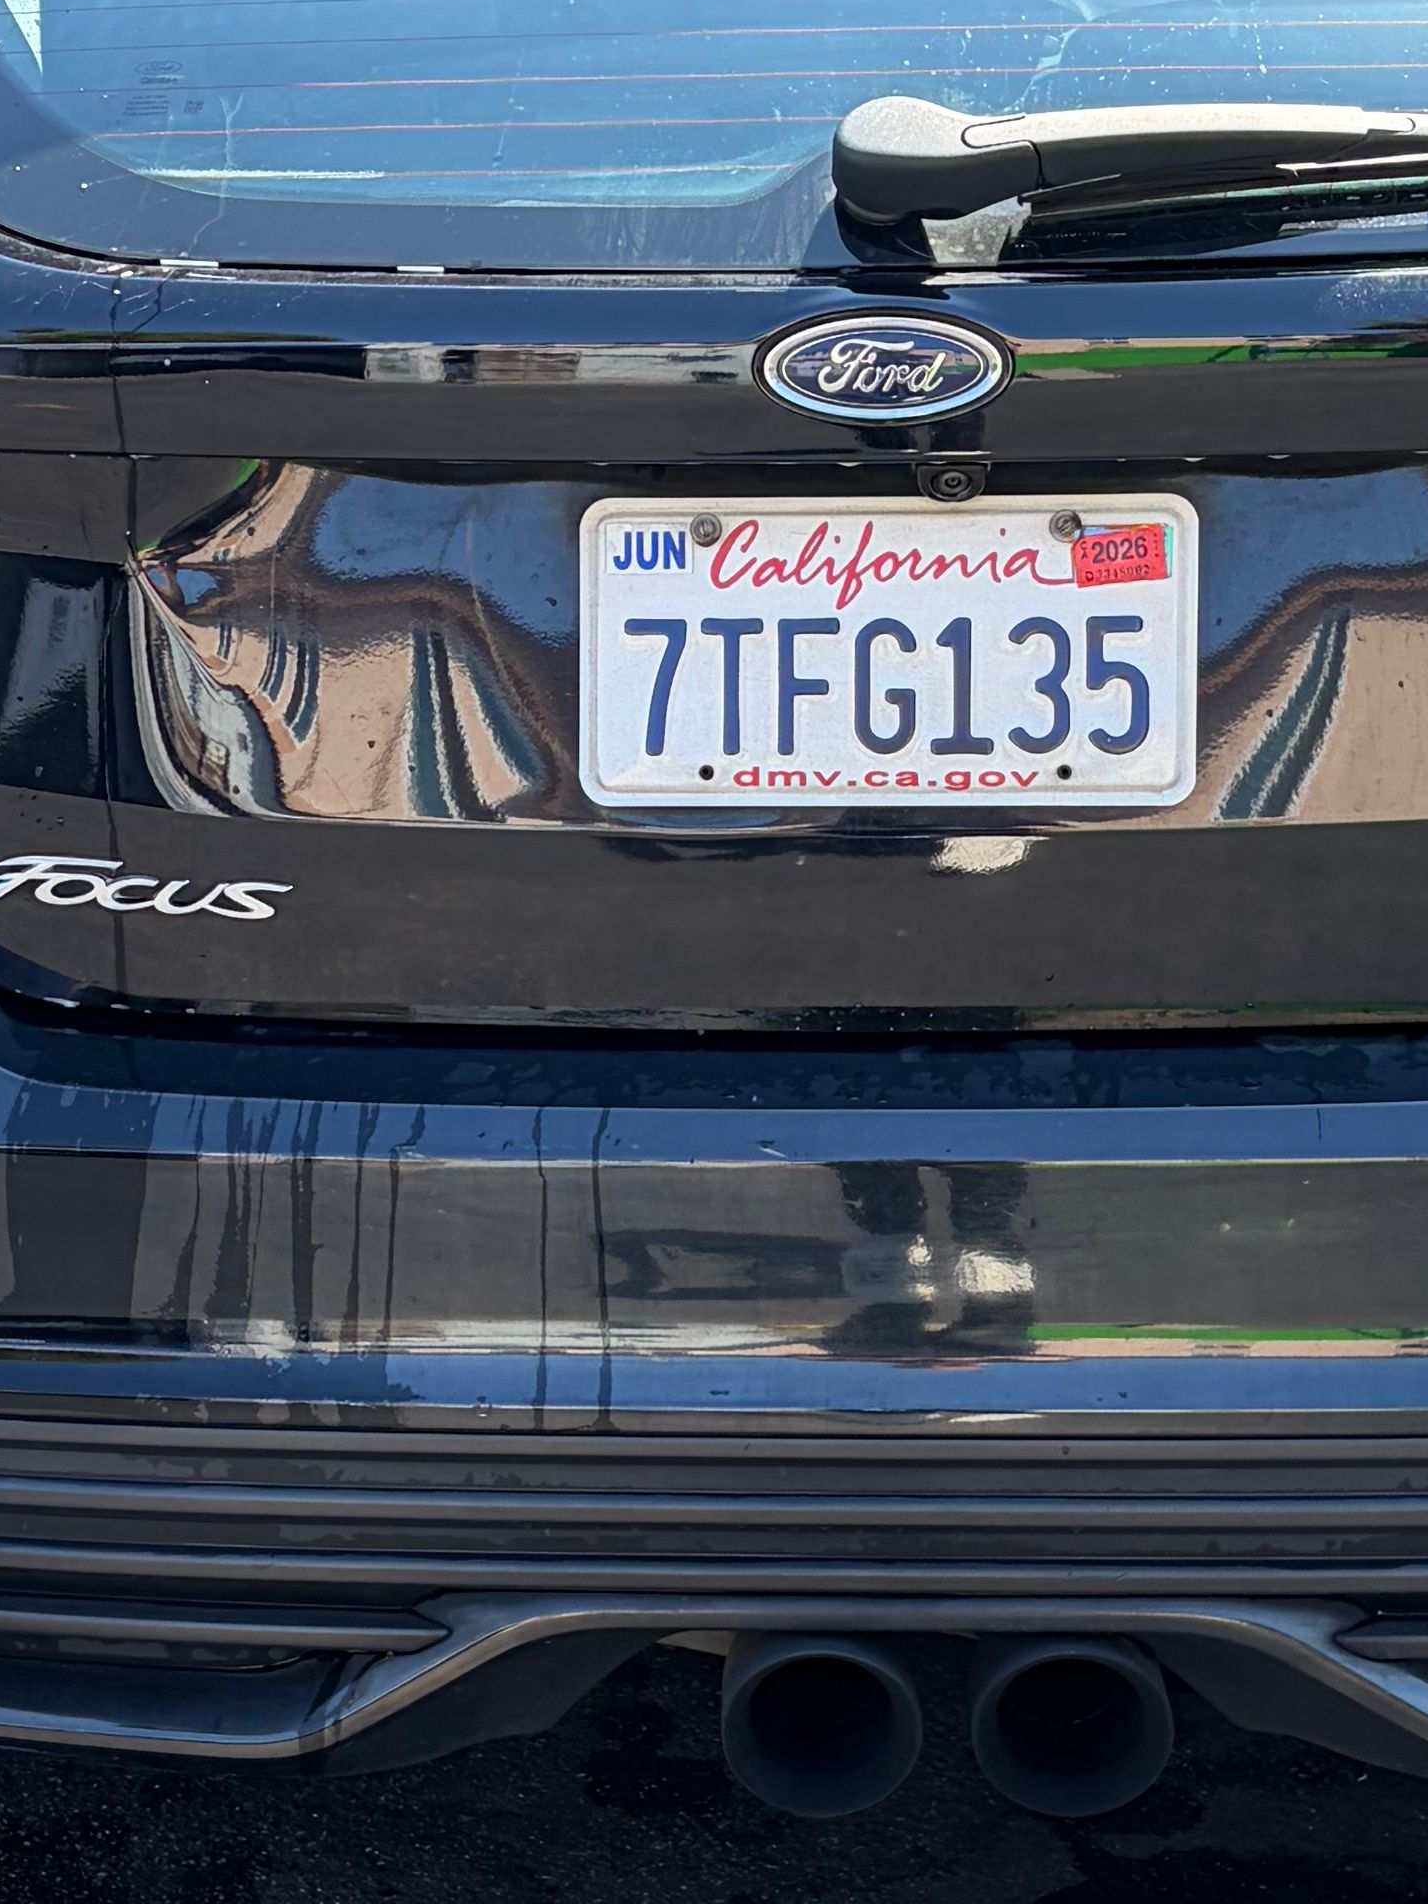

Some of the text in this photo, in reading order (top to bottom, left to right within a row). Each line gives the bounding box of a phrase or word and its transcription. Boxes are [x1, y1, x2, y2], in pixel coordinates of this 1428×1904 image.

[818, 339, 947, 394] Ford
[613, 531, 686, 571] JUN
[710, 520, 1076, 610] California
[1091, 536, 1148, 564] 2026
[623, 616, 1151, 757] 7TFG135
[733, 765, 1040, 791] dmv.ca.gov
